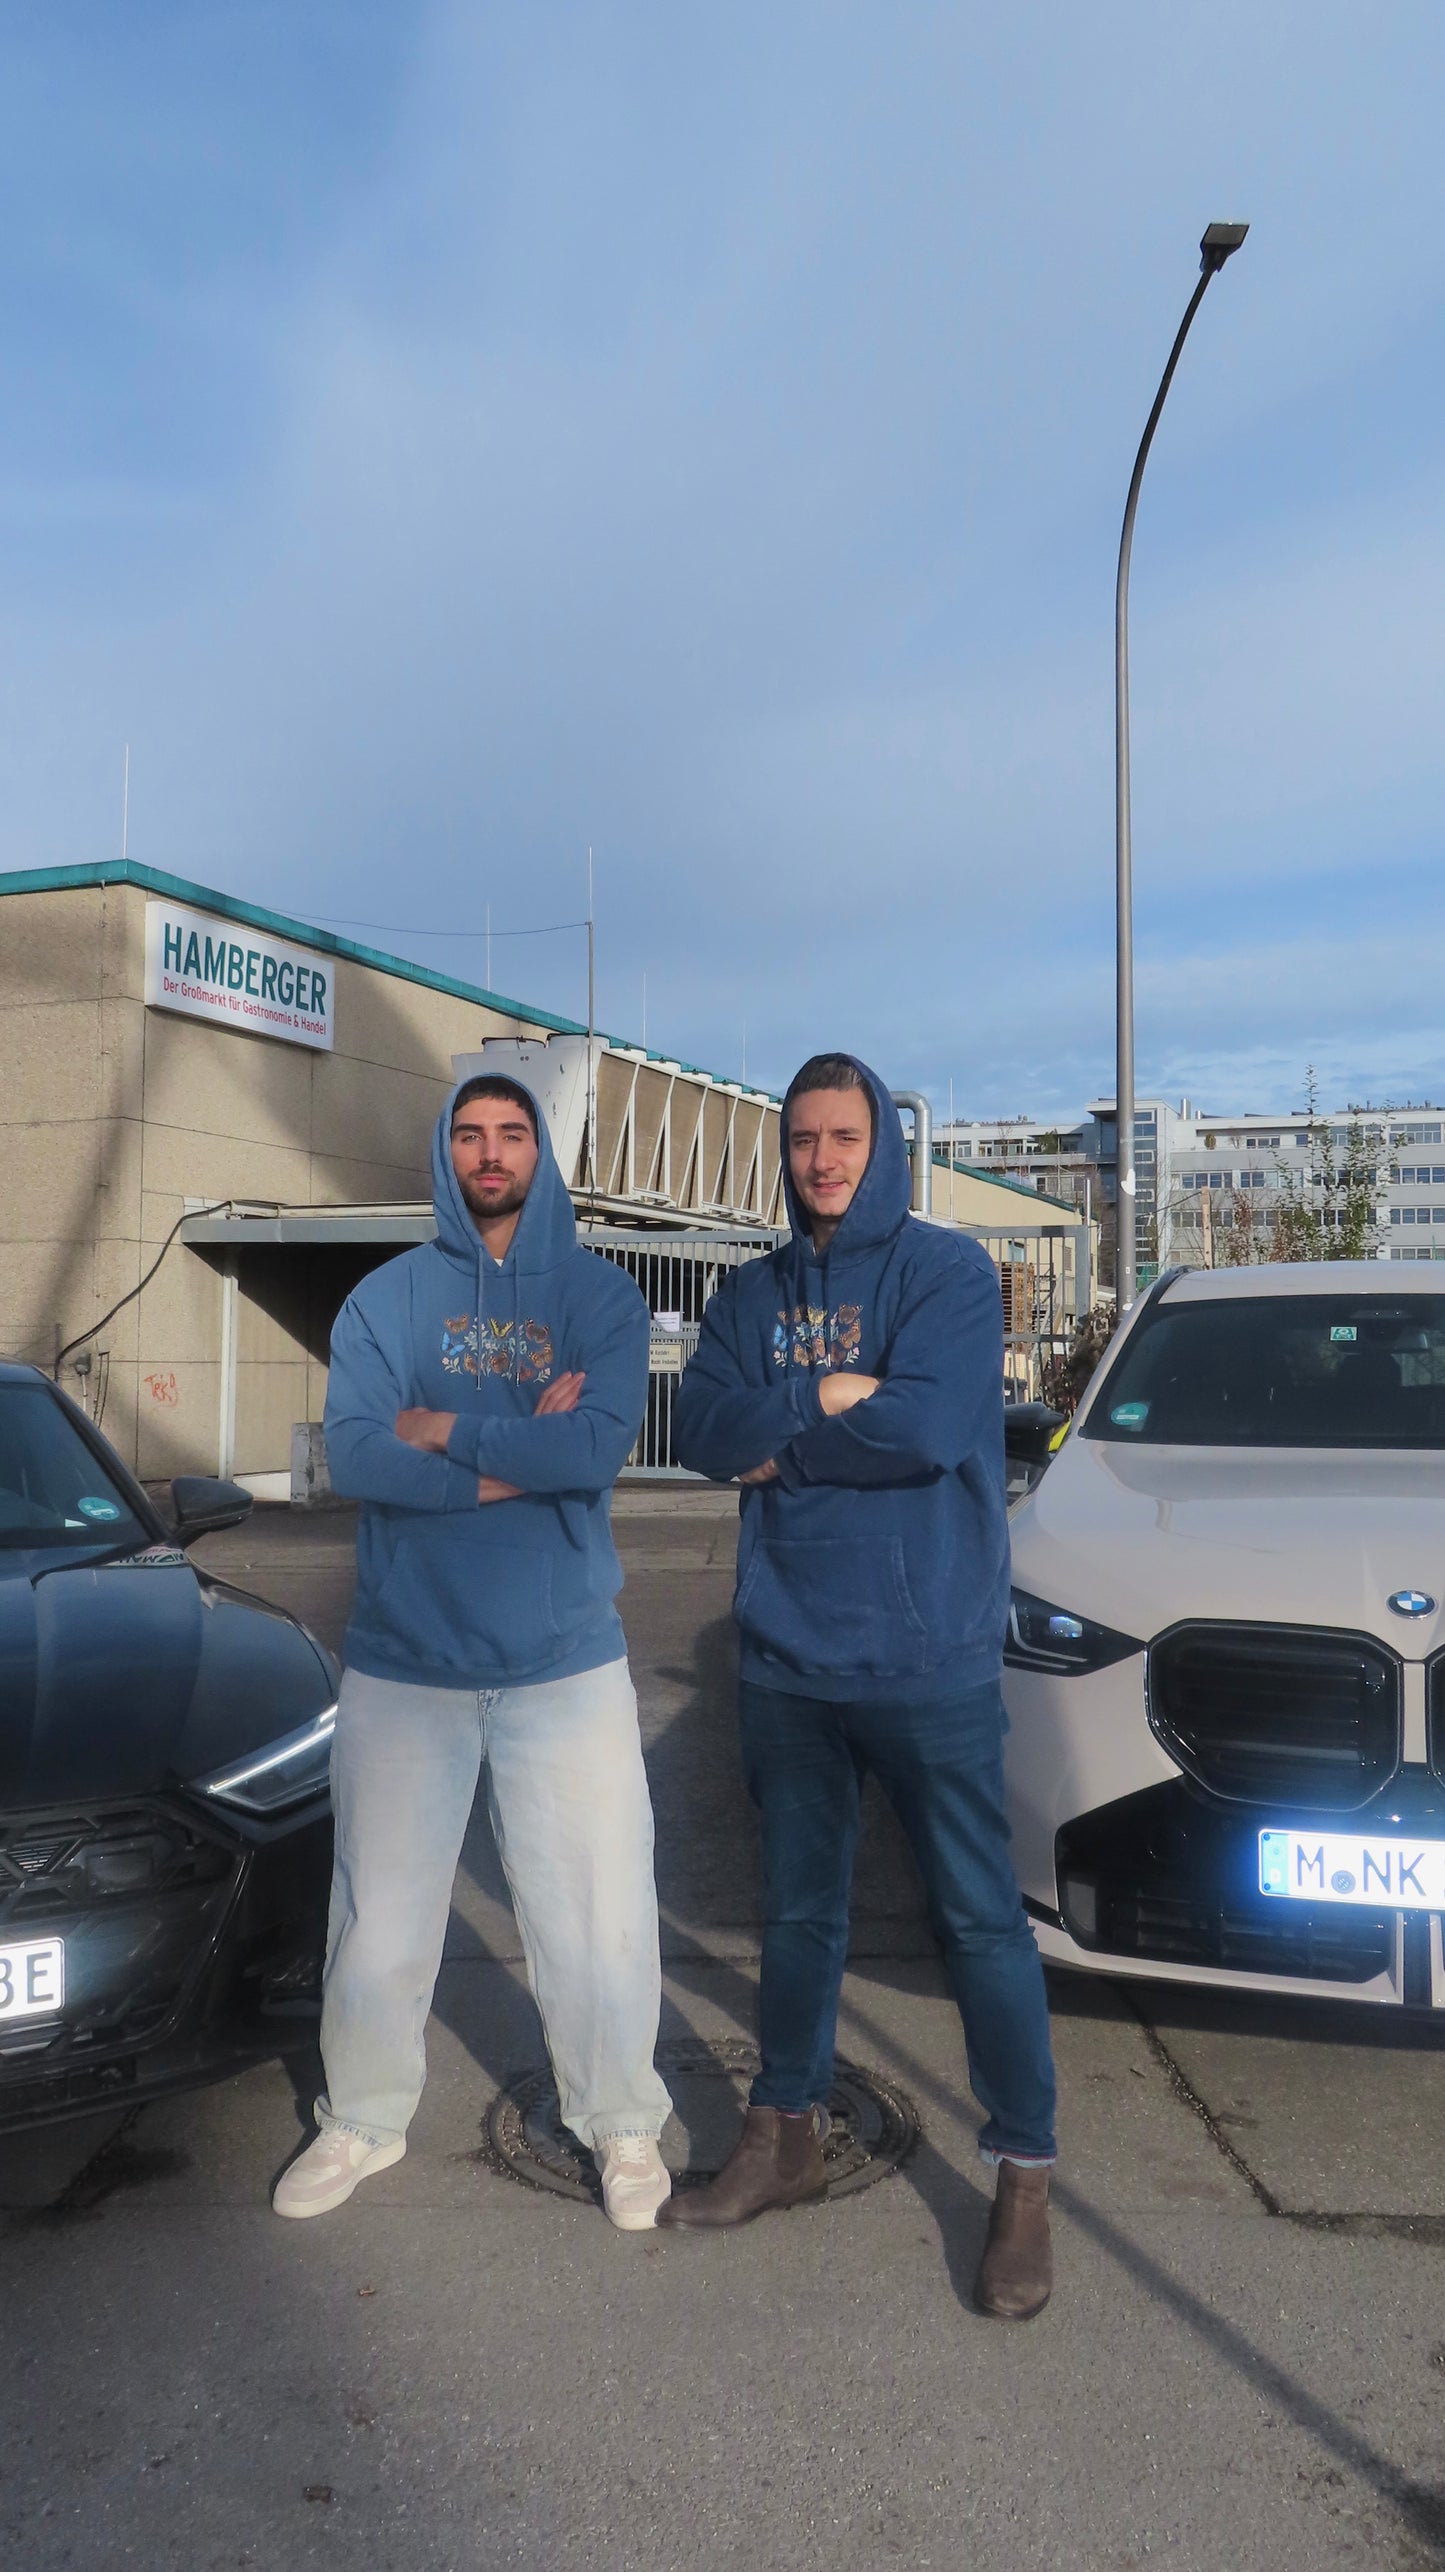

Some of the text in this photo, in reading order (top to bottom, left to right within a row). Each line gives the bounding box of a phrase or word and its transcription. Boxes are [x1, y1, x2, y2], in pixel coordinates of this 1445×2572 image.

[164, 922, 327, 1016] HAMBERGER
[163, 976, 327, 1035] Der Großmarkt für Gastronomie & Handel
[1297, 1844, 1324, 1888] M
[1363, 1849, 1427, 1897] NK
